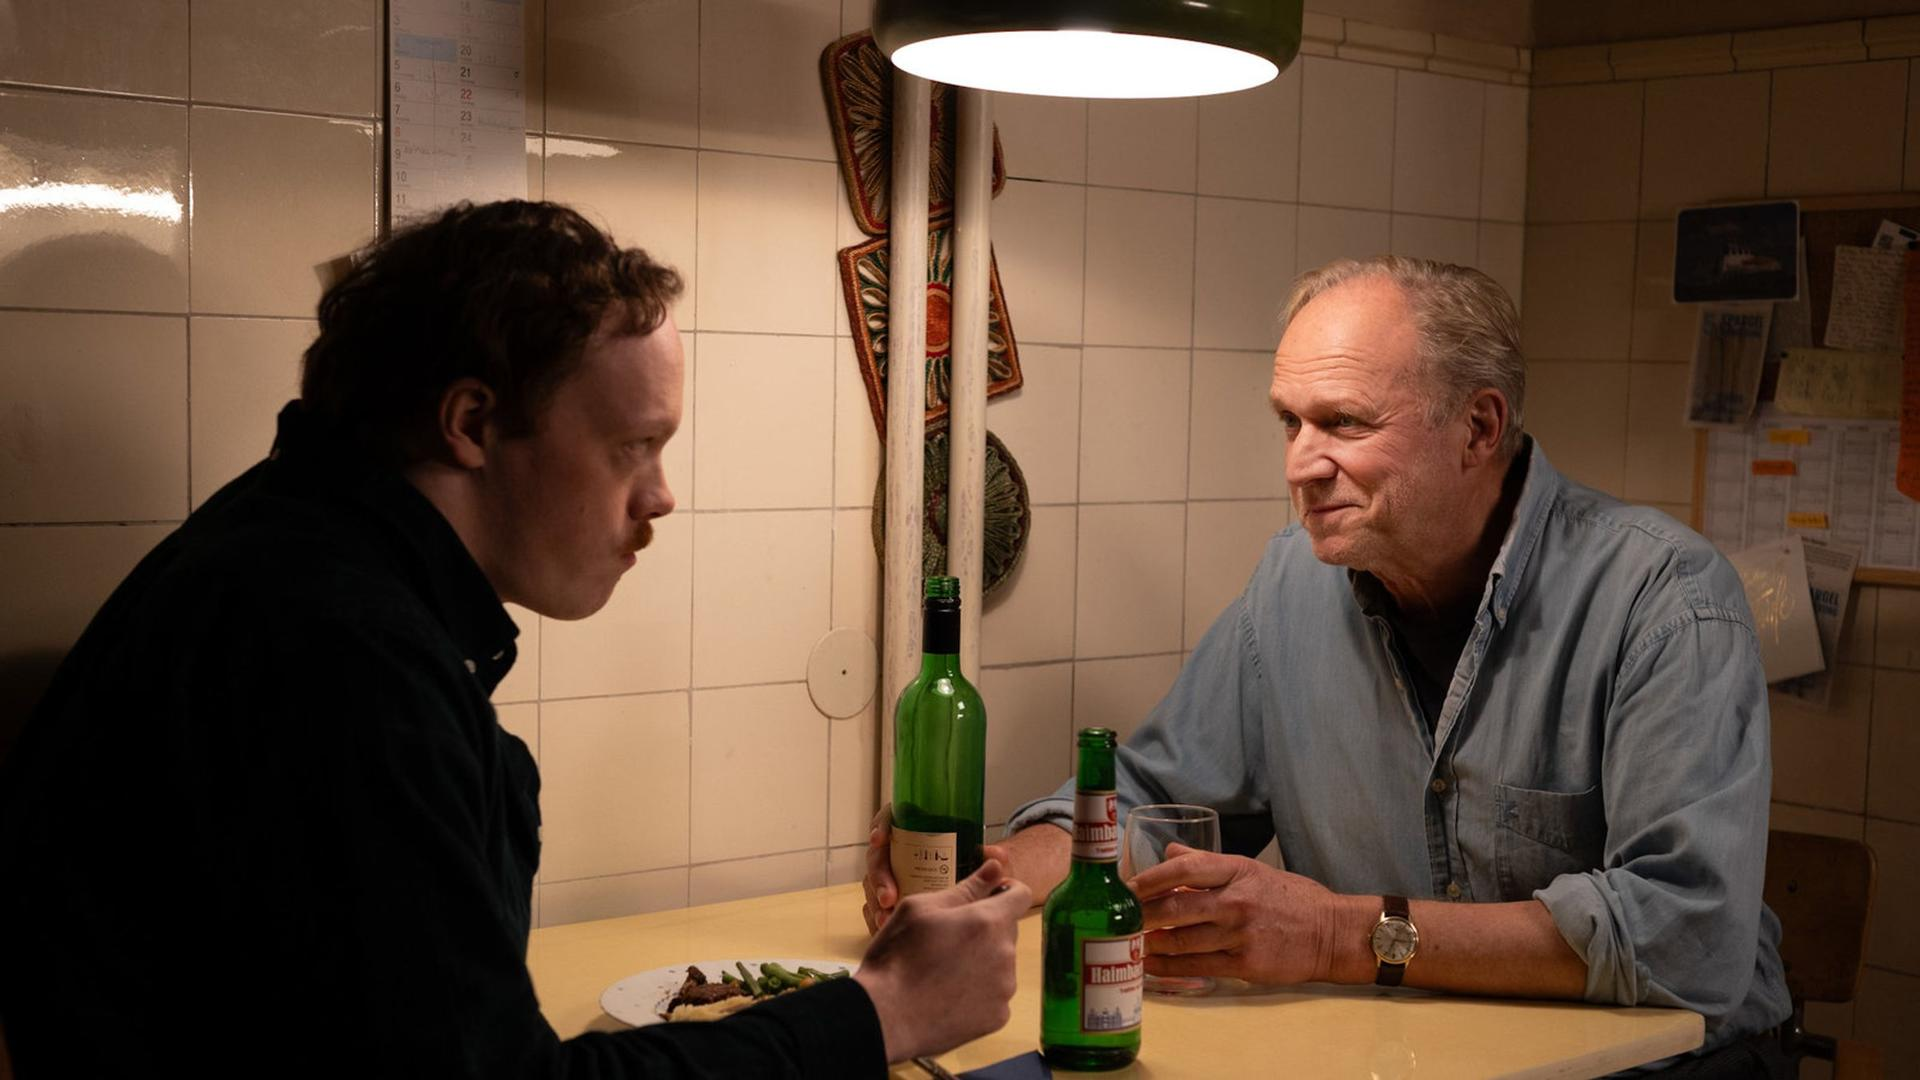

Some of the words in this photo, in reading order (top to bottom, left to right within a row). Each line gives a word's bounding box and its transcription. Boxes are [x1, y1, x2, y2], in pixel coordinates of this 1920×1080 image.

[460, 45, 472, 57] 20
[394, 59, 400, 70] 5
[460, 66, 471, 78] 21
[394, 81, 401, 92] 6
[460, 88, 472, 100] 22
[395, 103, 401, 115] 7
[460, 110, 472, 122] 23
[394, 148, 401, 160] 9
[395, 170, 407, 182] 10
[396, 192, 406, 205] 11
